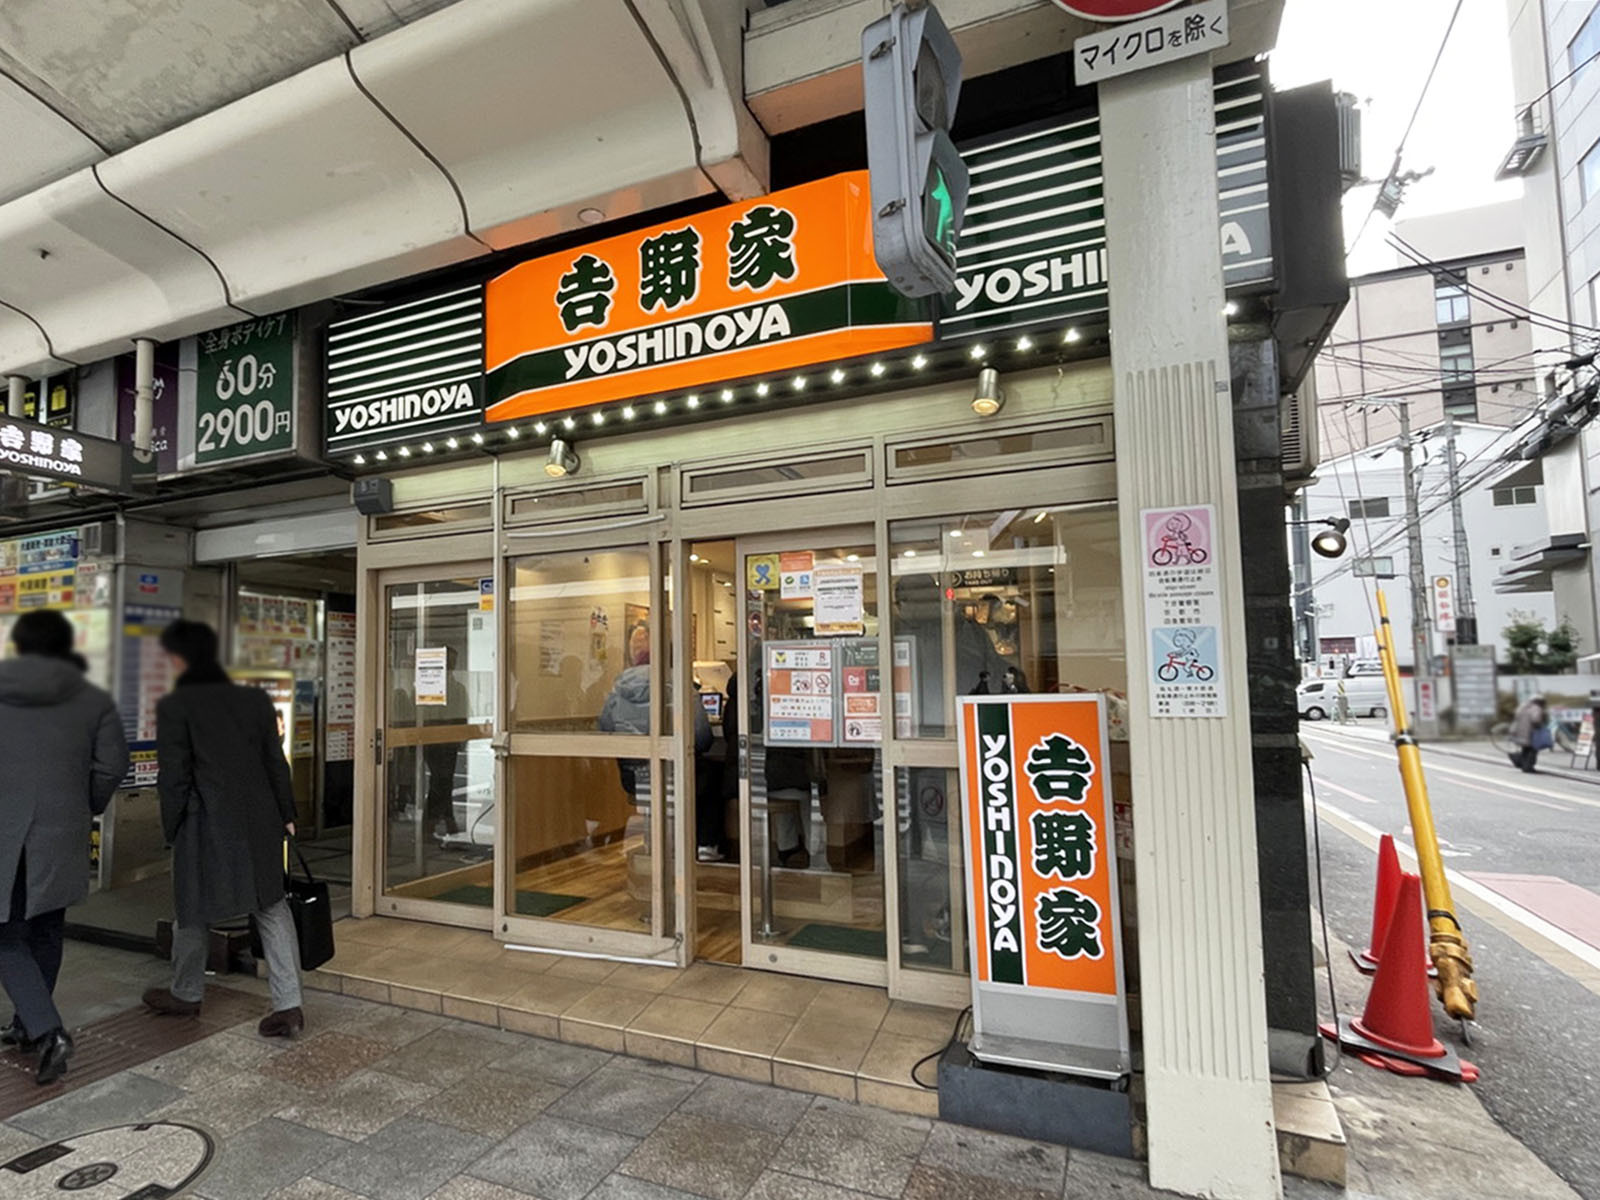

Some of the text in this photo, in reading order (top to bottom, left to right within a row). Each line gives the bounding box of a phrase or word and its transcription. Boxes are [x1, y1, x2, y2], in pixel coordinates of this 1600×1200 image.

[1080, 14, 1223, 70] マイクロを除く
[564, 303, 791, 380] YOSHINOYA
[215, 354, 277, 400] 60分
[198, 400, 291, 452] 2900円
[335, 383, 474, 433] YOSHINOYA
[982, 734, 1019, 953] YOSHINOYA
